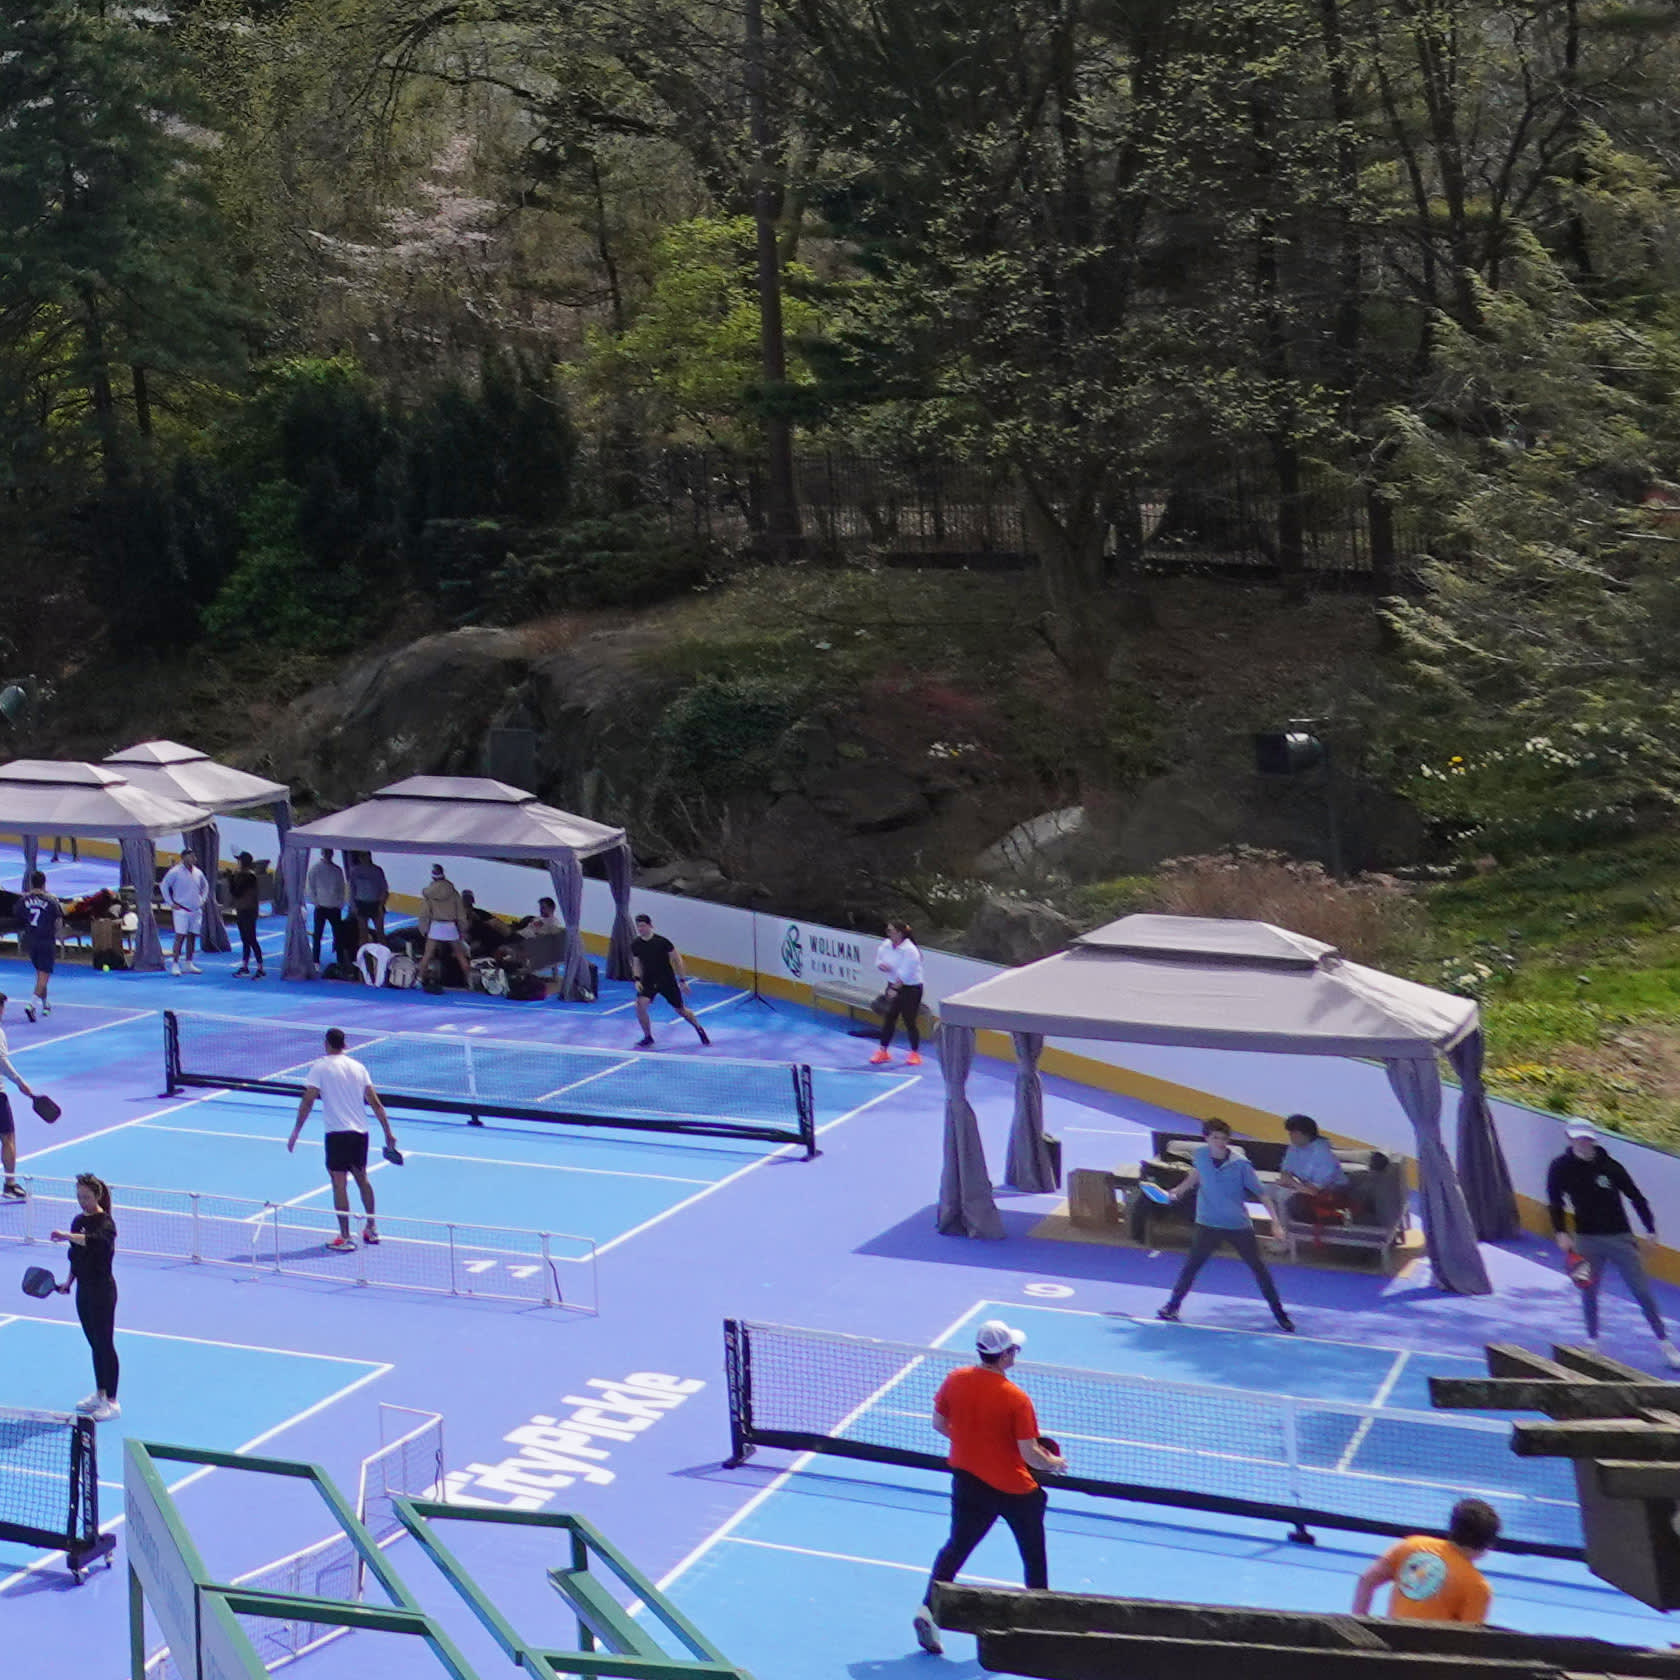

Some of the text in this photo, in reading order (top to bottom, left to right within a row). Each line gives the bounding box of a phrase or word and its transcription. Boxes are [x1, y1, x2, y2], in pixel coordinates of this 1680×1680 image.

[29, 908, 41, 927] 7
[809, 934, 861, 963] WOLLMAN
[421, 1371, 707, 1505] CityPickle
